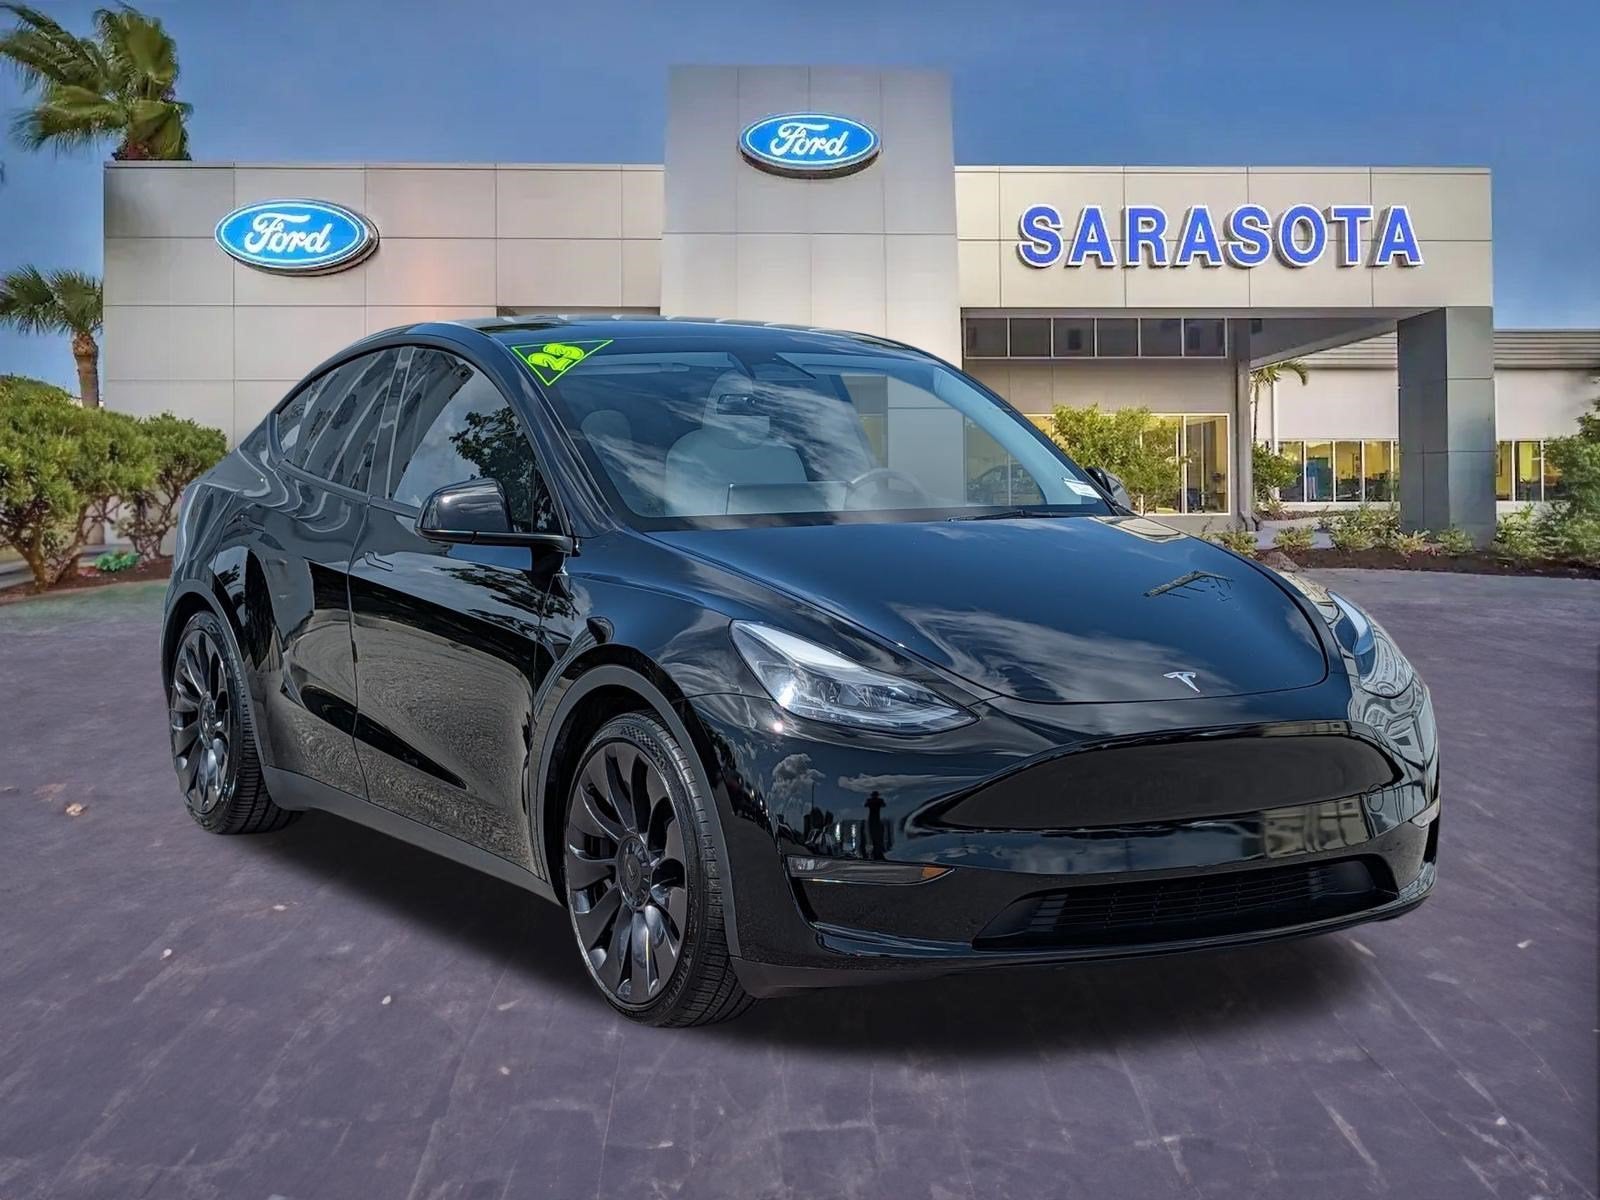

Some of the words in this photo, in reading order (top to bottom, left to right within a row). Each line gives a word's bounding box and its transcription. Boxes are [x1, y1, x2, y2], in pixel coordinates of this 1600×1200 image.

[769, 122, 849, 157] Ford
[243, 212, 333, 254] Ford
[1017, 204, 1425, 268] SARASOTA
